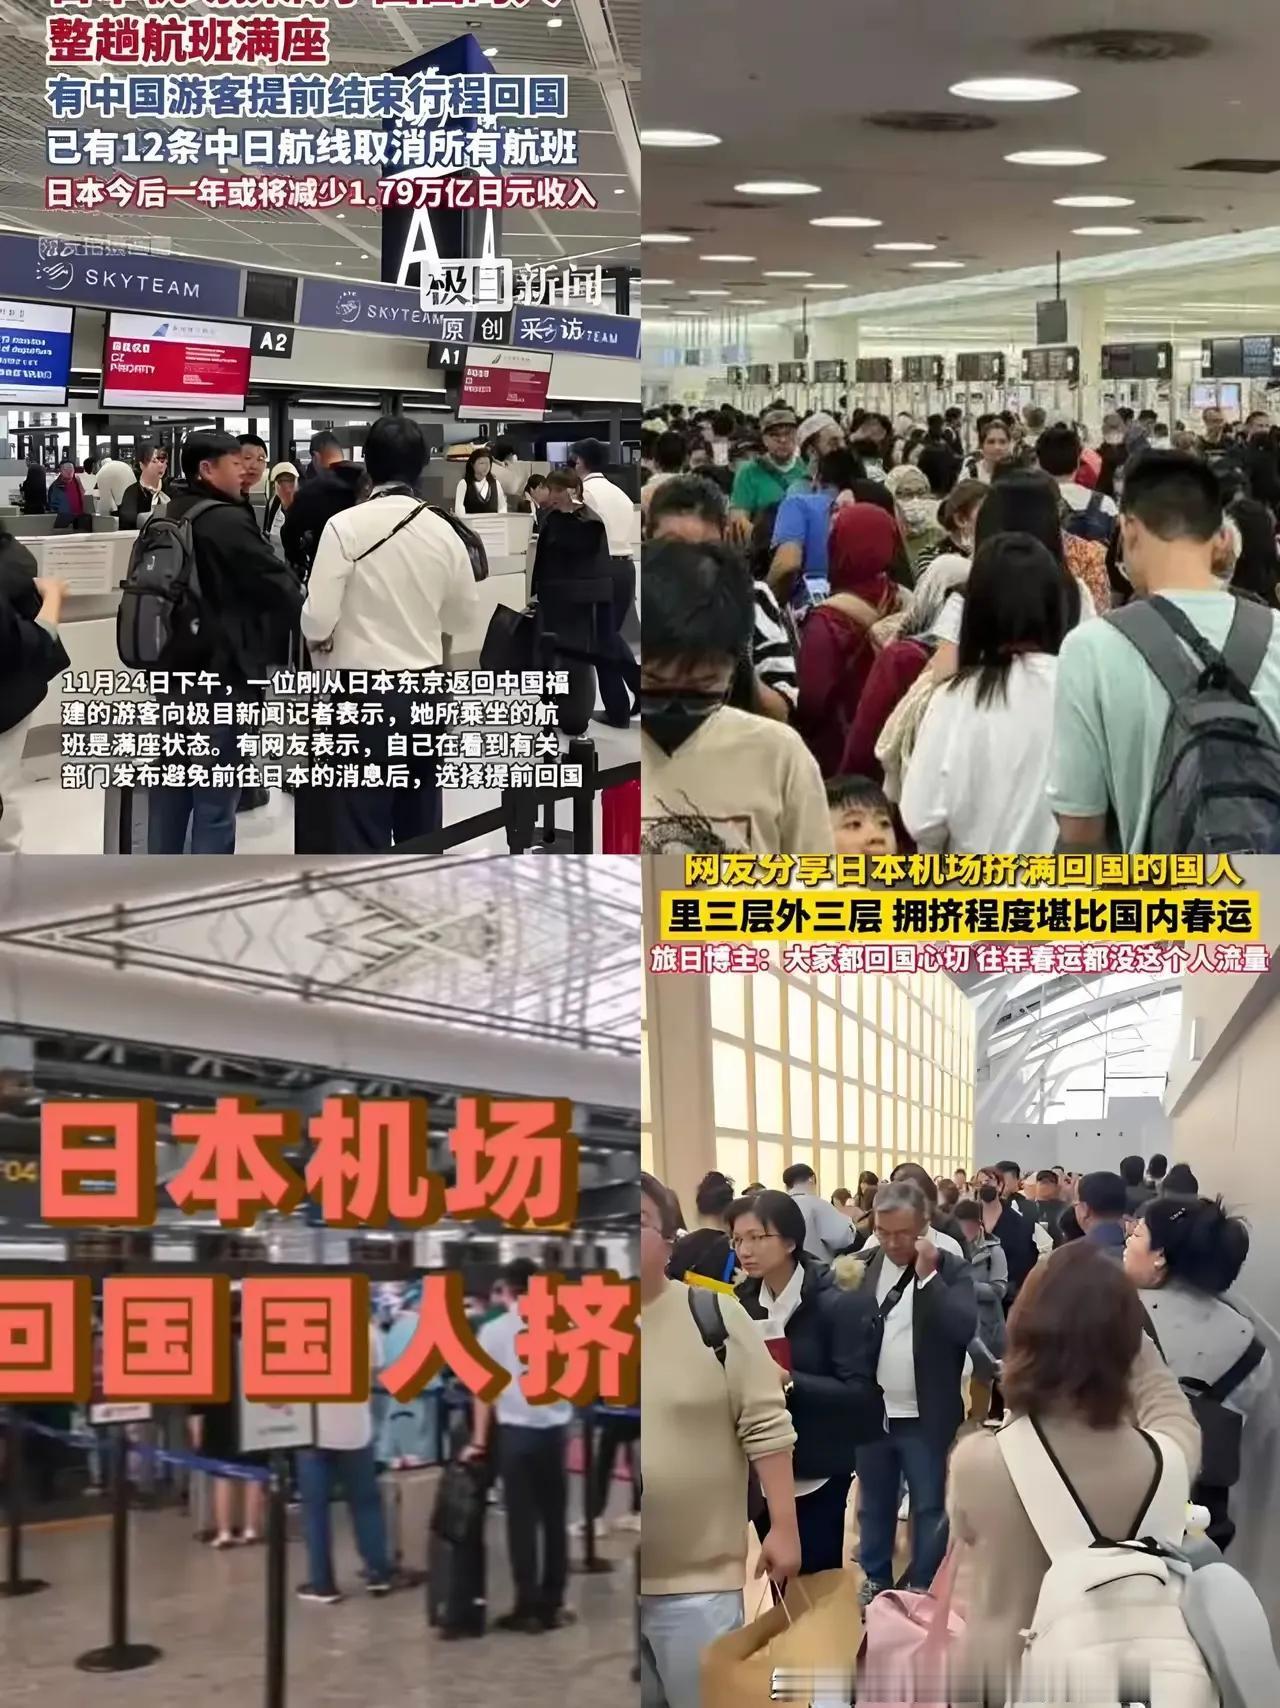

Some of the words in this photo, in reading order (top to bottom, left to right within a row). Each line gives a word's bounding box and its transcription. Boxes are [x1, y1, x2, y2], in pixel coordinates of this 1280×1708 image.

[85, 269, 200, 299] SKYTEAM
[259, 331, 288, 352] A2
[439, 347, 460, 365] A1
